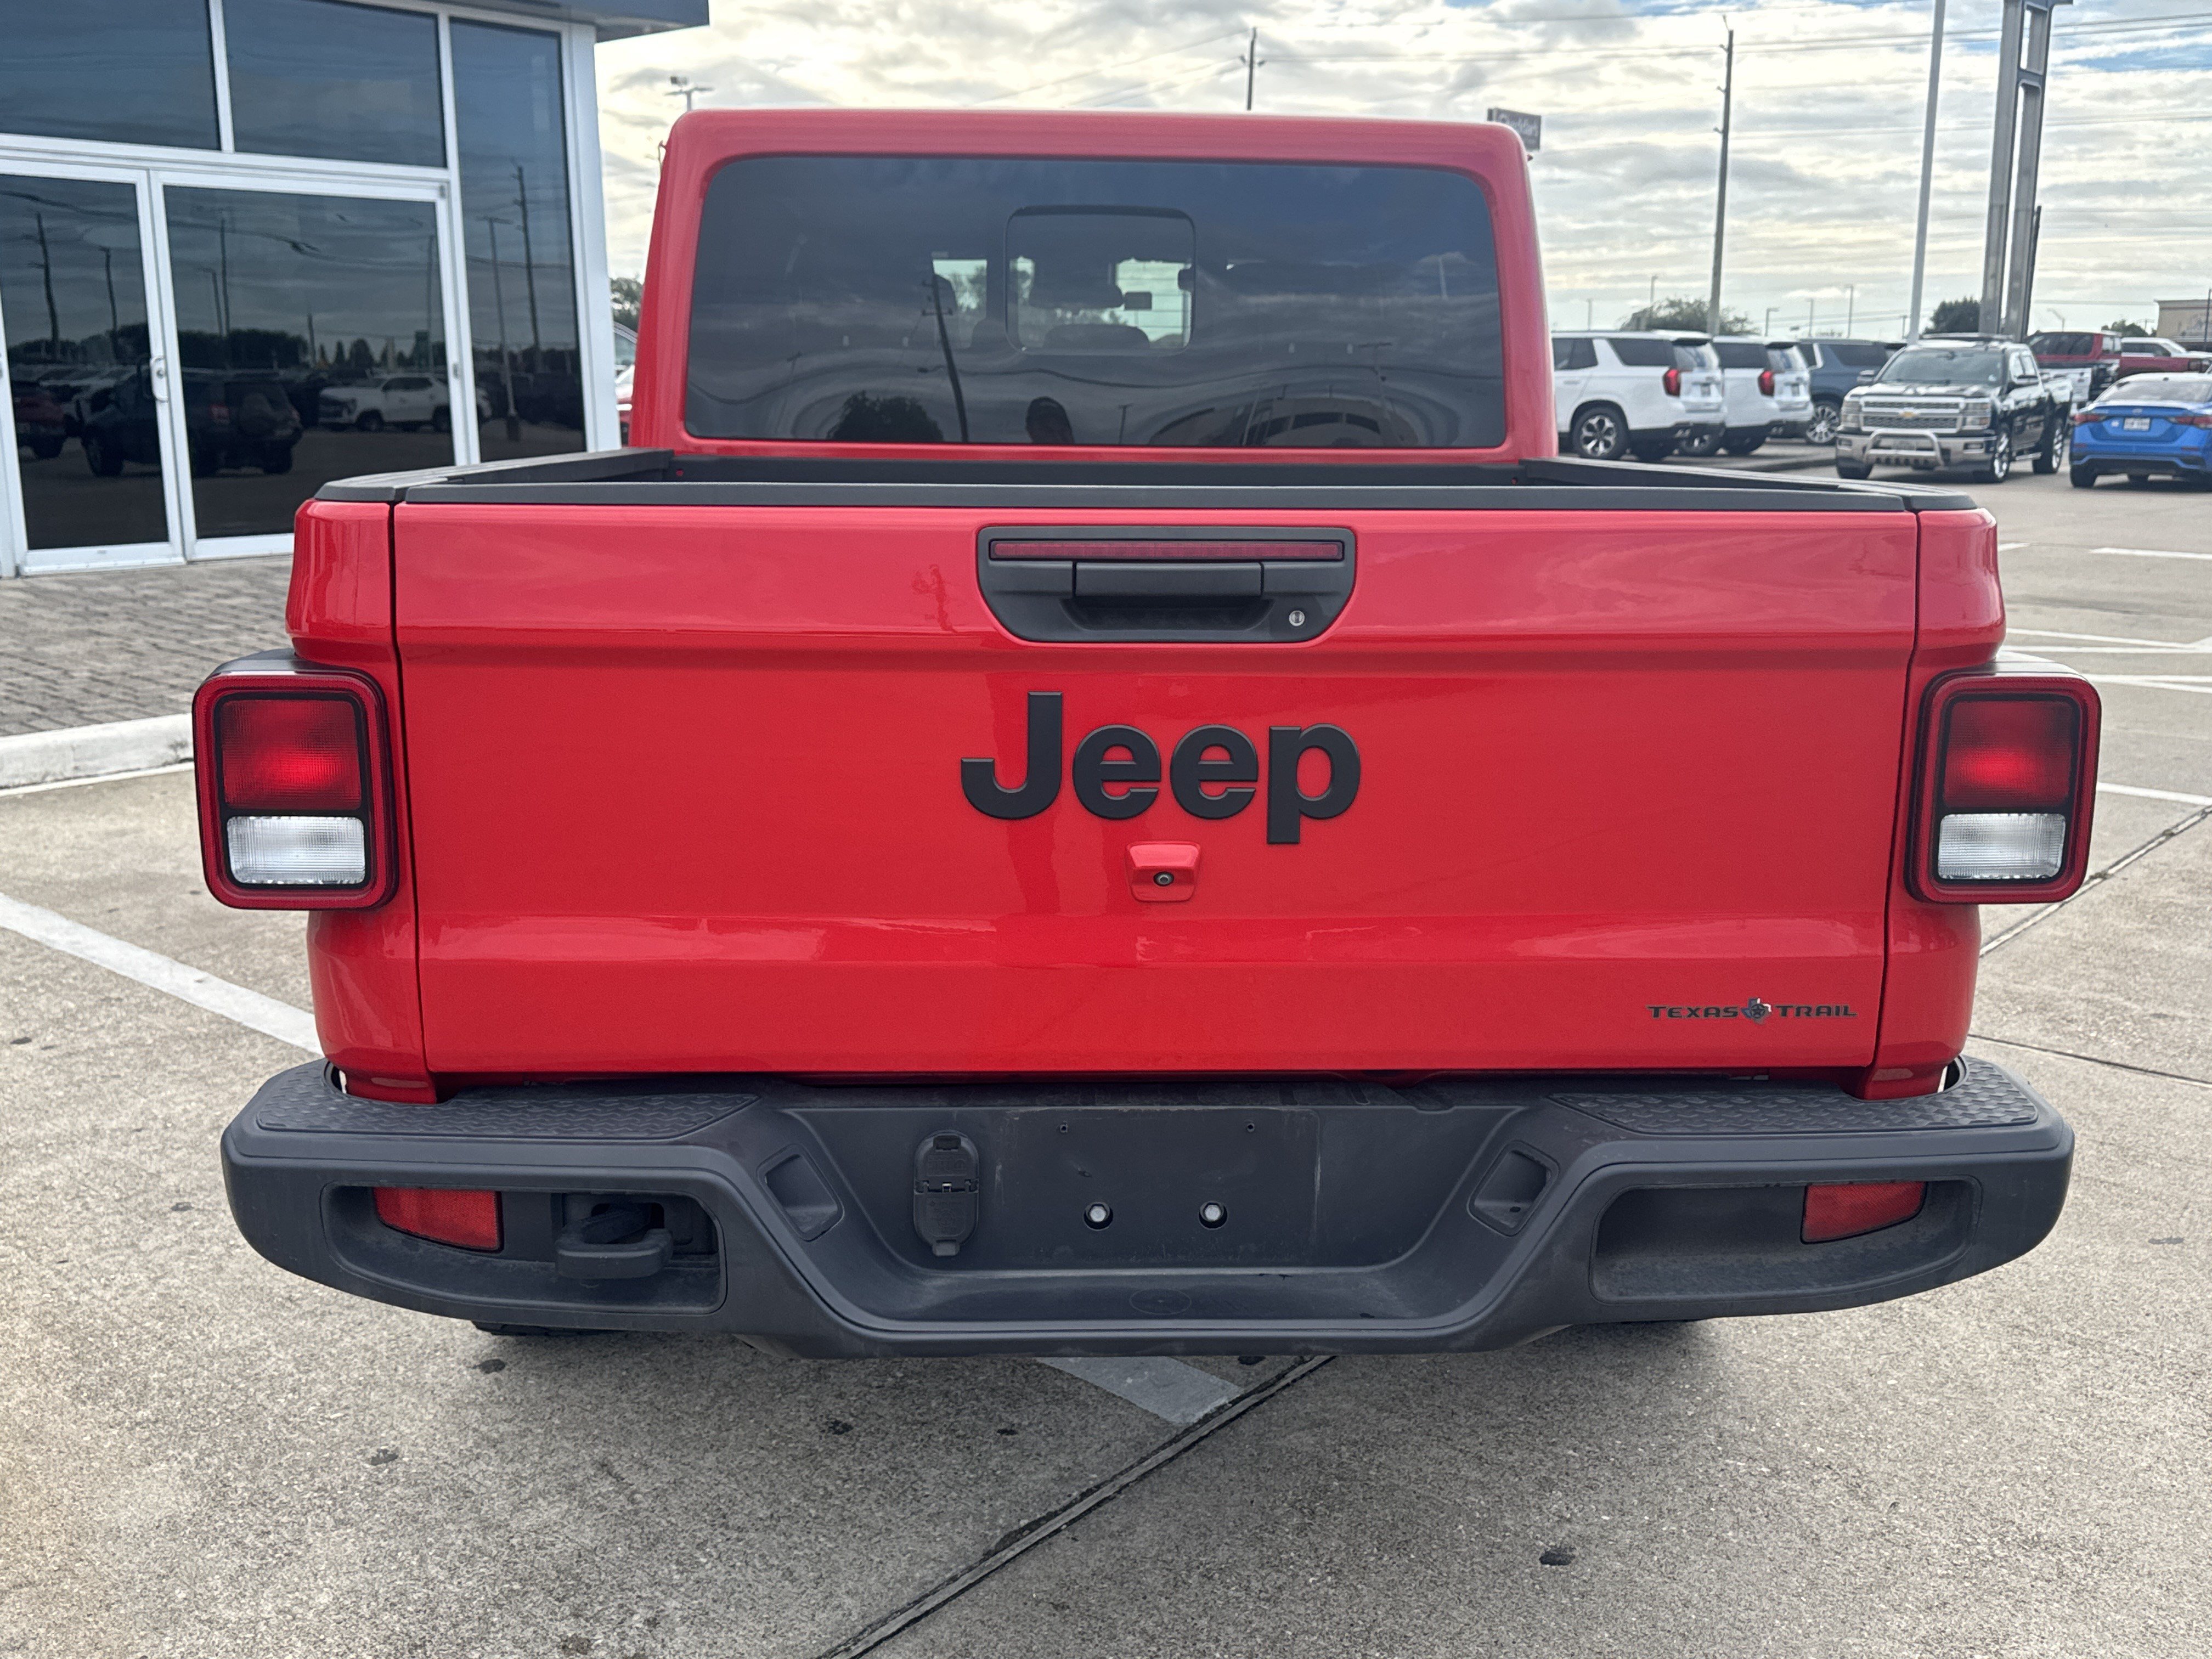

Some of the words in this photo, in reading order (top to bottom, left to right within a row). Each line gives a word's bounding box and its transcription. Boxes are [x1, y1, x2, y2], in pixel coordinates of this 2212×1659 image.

[961, 691, 1361, 845] Jeep
[1647, 1005, 1739, 1019] TEXAS
[1775, 1005, 1858, 1018] TRAIL
